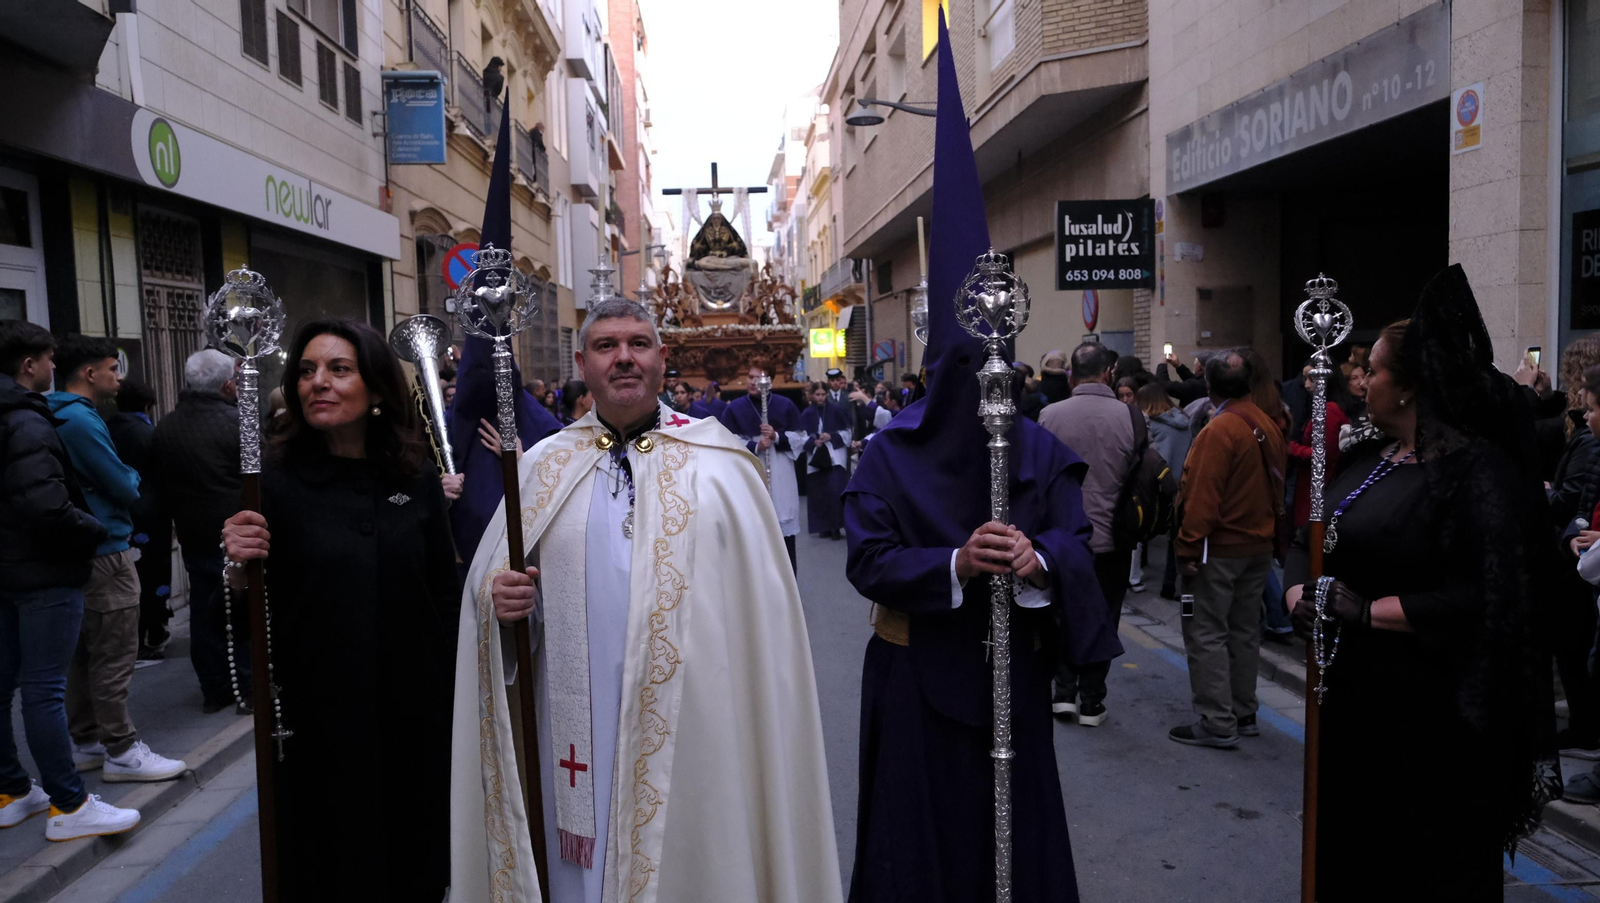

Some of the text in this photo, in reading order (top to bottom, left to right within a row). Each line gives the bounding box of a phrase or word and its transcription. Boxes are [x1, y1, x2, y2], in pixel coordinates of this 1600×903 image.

[390, 87, 438, 104] Roca
[1172, 129, 1232, 183] Edificio
[1238, 70, 1353, 159] SORIANO
[155, 133, 175, 176] nl
[265, 174, 332, 231] newlar
[1064, 213, 1123, 236] tusalud
[1065, 238, 1140, 262] pilates
[1065, 268, 1142, 281] 653 094 808
